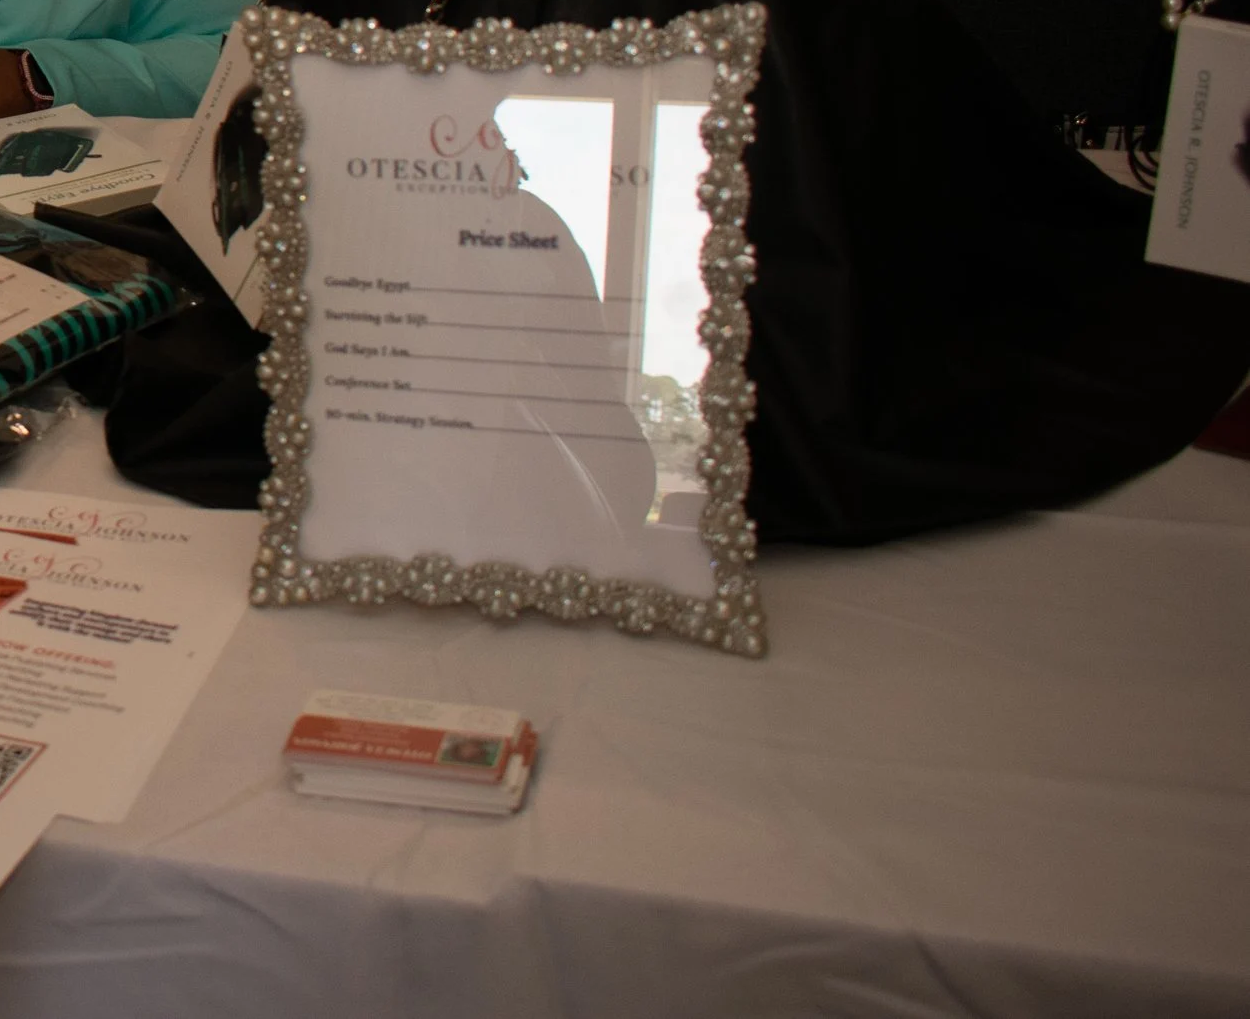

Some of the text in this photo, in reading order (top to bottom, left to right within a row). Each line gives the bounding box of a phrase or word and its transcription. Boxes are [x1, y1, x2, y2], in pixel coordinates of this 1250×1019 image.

[347, 157, 488, 182] OTESCIA
[1178, 155, 1199, 230] JOHNSON
[458, 229, 559, 250] Price Sheet
